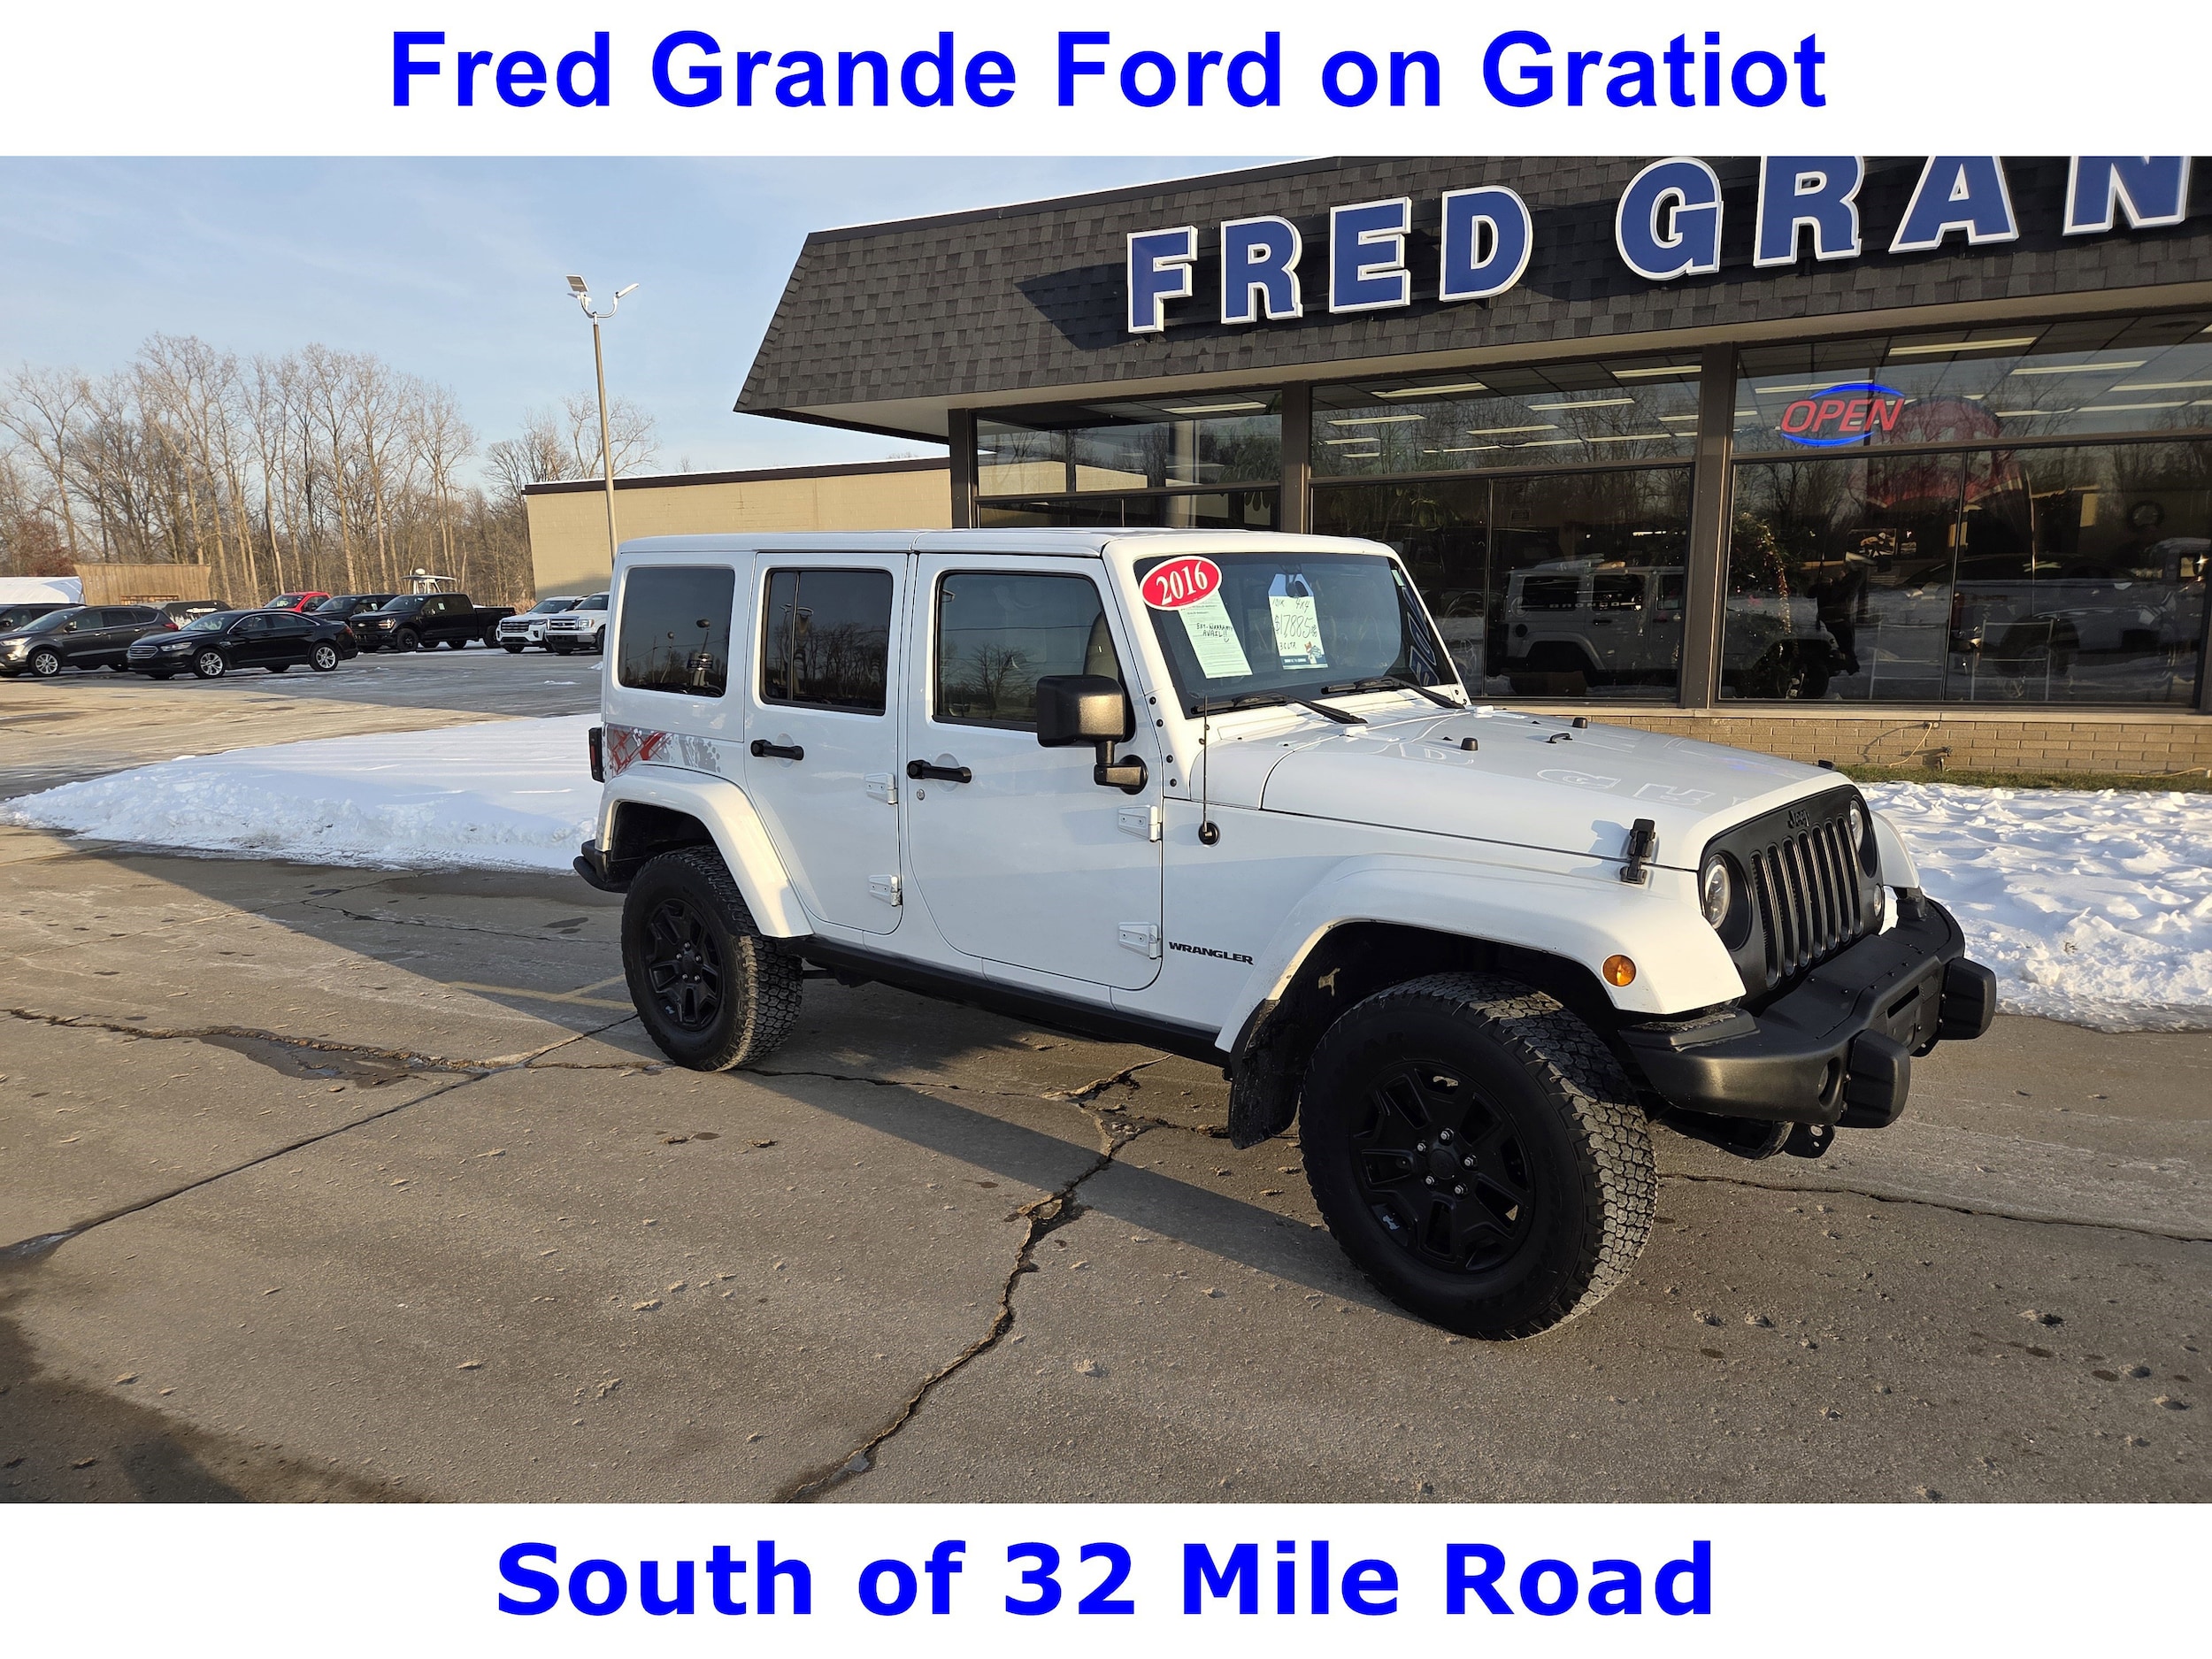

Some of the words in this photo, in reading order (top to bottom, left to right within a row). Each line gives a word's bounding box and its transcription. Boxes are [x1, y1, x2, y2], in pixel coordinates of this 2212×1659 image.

[1126, 185, 1533, 334] FRED
[1780, 398, 1905, 433] OPEN
[1156, 561, 1209, 606] 2016
[1787, 809, 1810, 829] Jeep
[1168, 941, 1255, 965] WRANGLER
